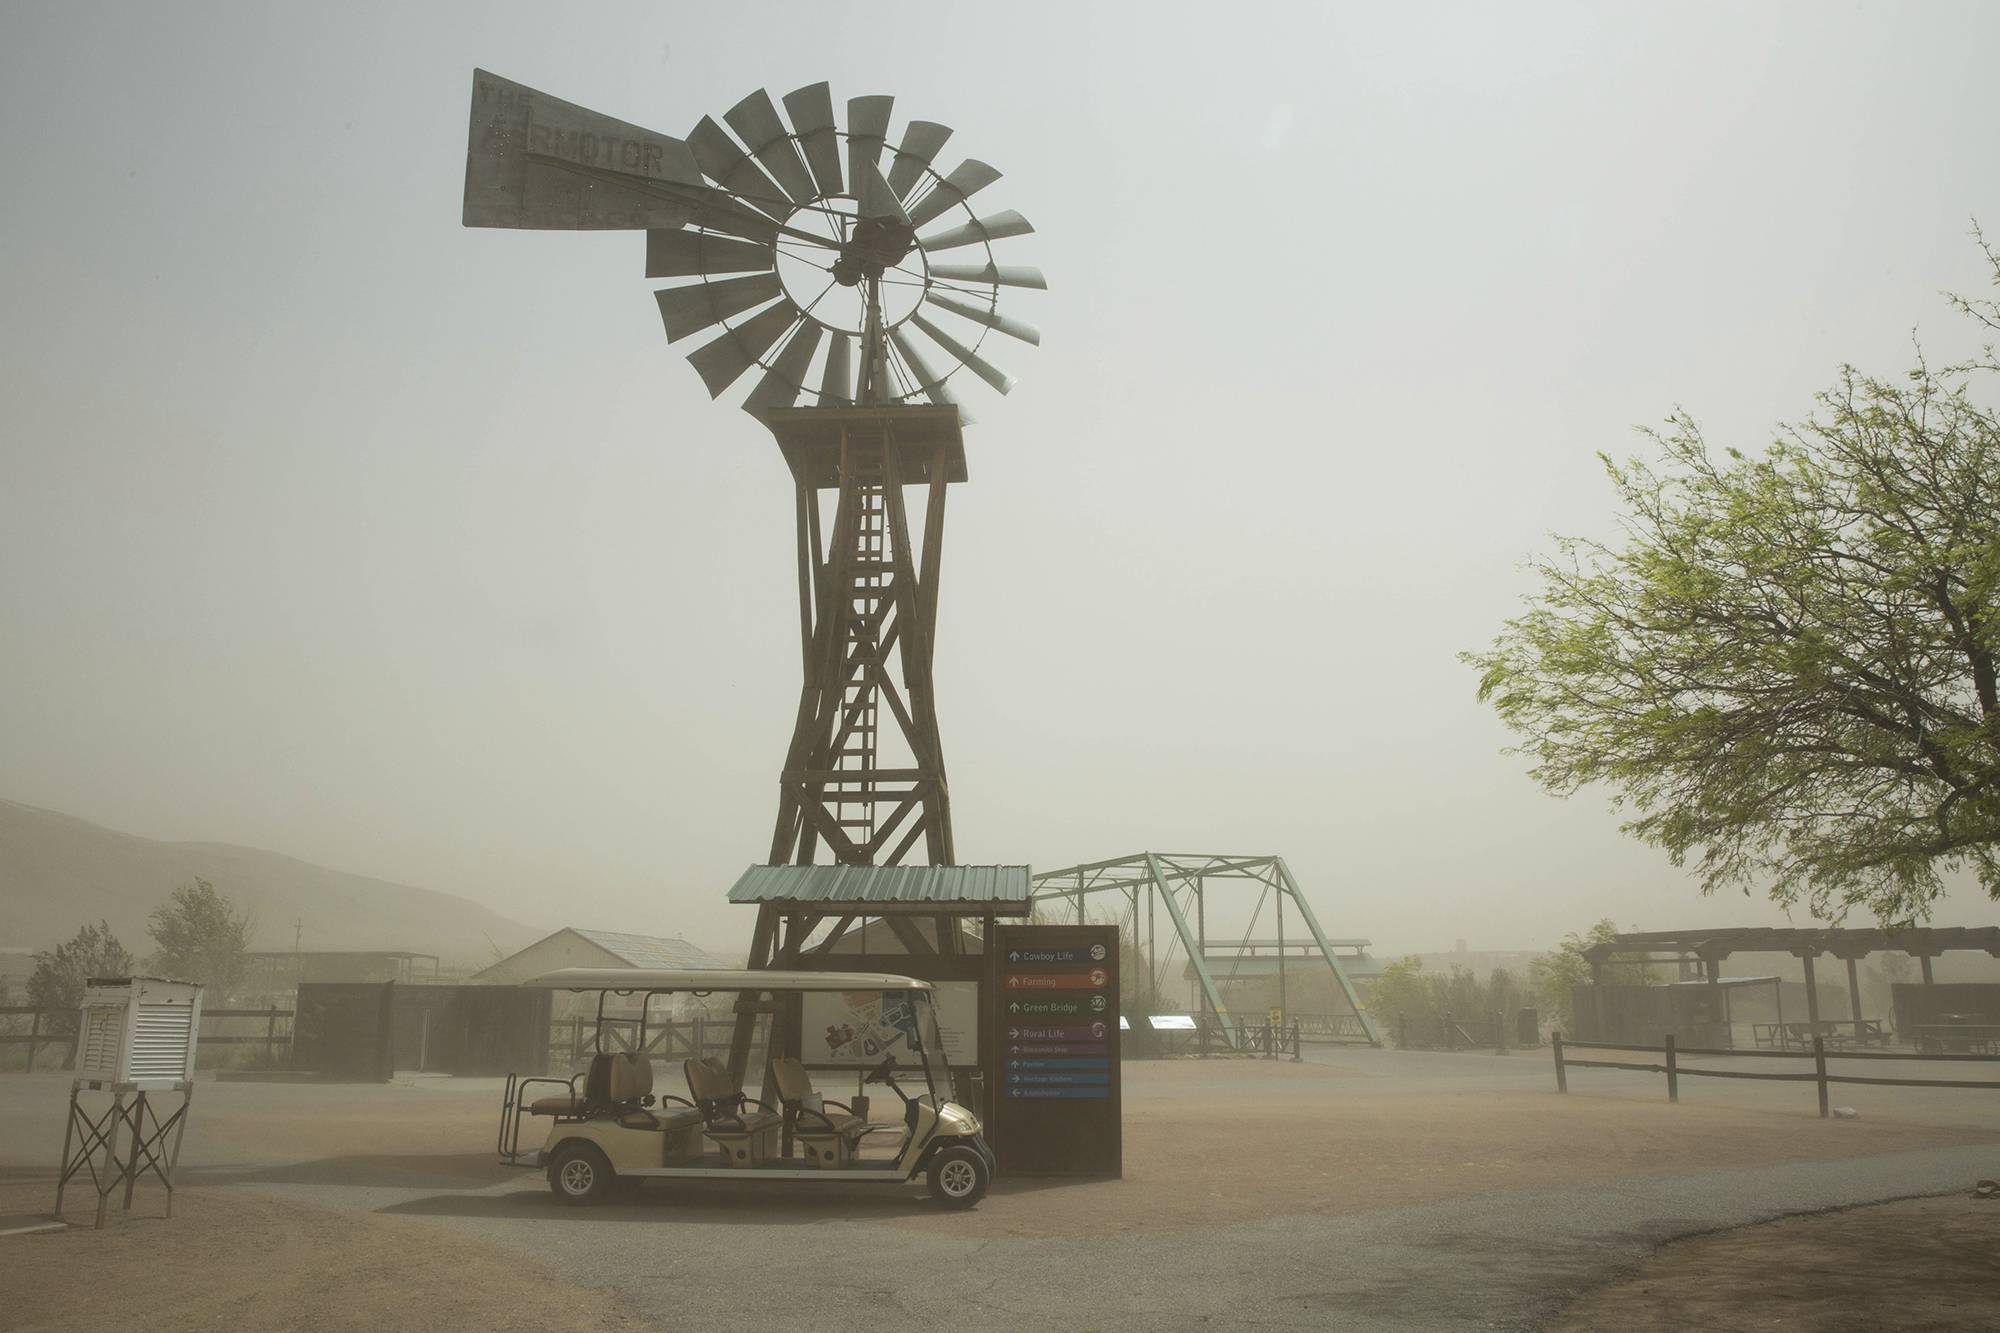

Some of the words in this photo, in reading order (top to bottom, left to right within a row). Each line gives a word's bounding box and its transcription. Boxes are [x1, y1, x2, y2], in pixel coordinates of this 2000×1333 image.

[1023, 951, 1055, 962] Cowboy
[1057, 951, 1073, 961] Life
[1023, 977, 1056, 988] Farming
[1023, 1003, 1048, 1012] Green
[1050, 1002, 1078, 1014] Bridge
[1023, 1029, 1045, 1038] Rural
[1048, 1029, 1065, 1038] Life
